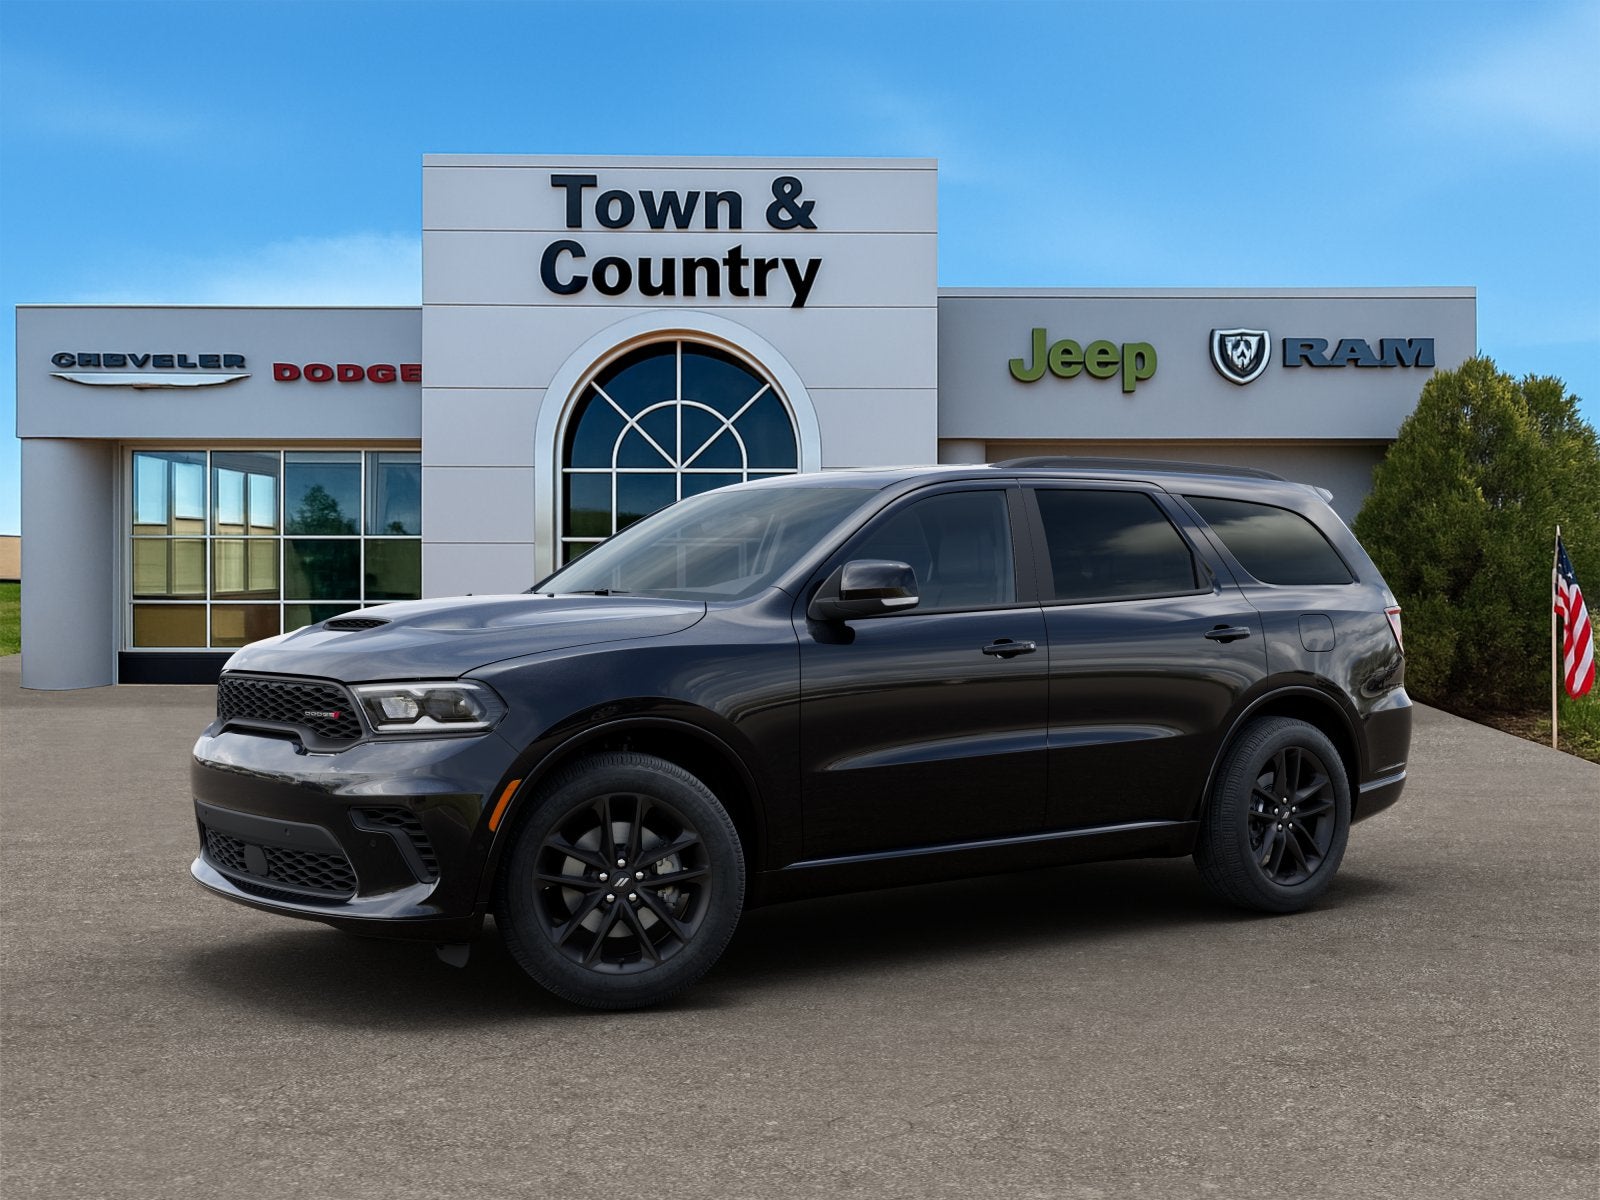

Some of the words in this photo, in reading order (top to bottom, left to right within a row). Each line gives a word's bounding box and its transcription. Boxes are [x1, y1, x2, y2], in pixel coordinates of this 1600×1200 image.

[550, 174, 743, 230] Town
[765, 175, 818, 230] &
[540, 239, 822, 308] Country
[272, 362, 422, 383] DODGE
[1009, 327, 1157, 392] Jeep
[1282, 337, 1435, 368] RAM
